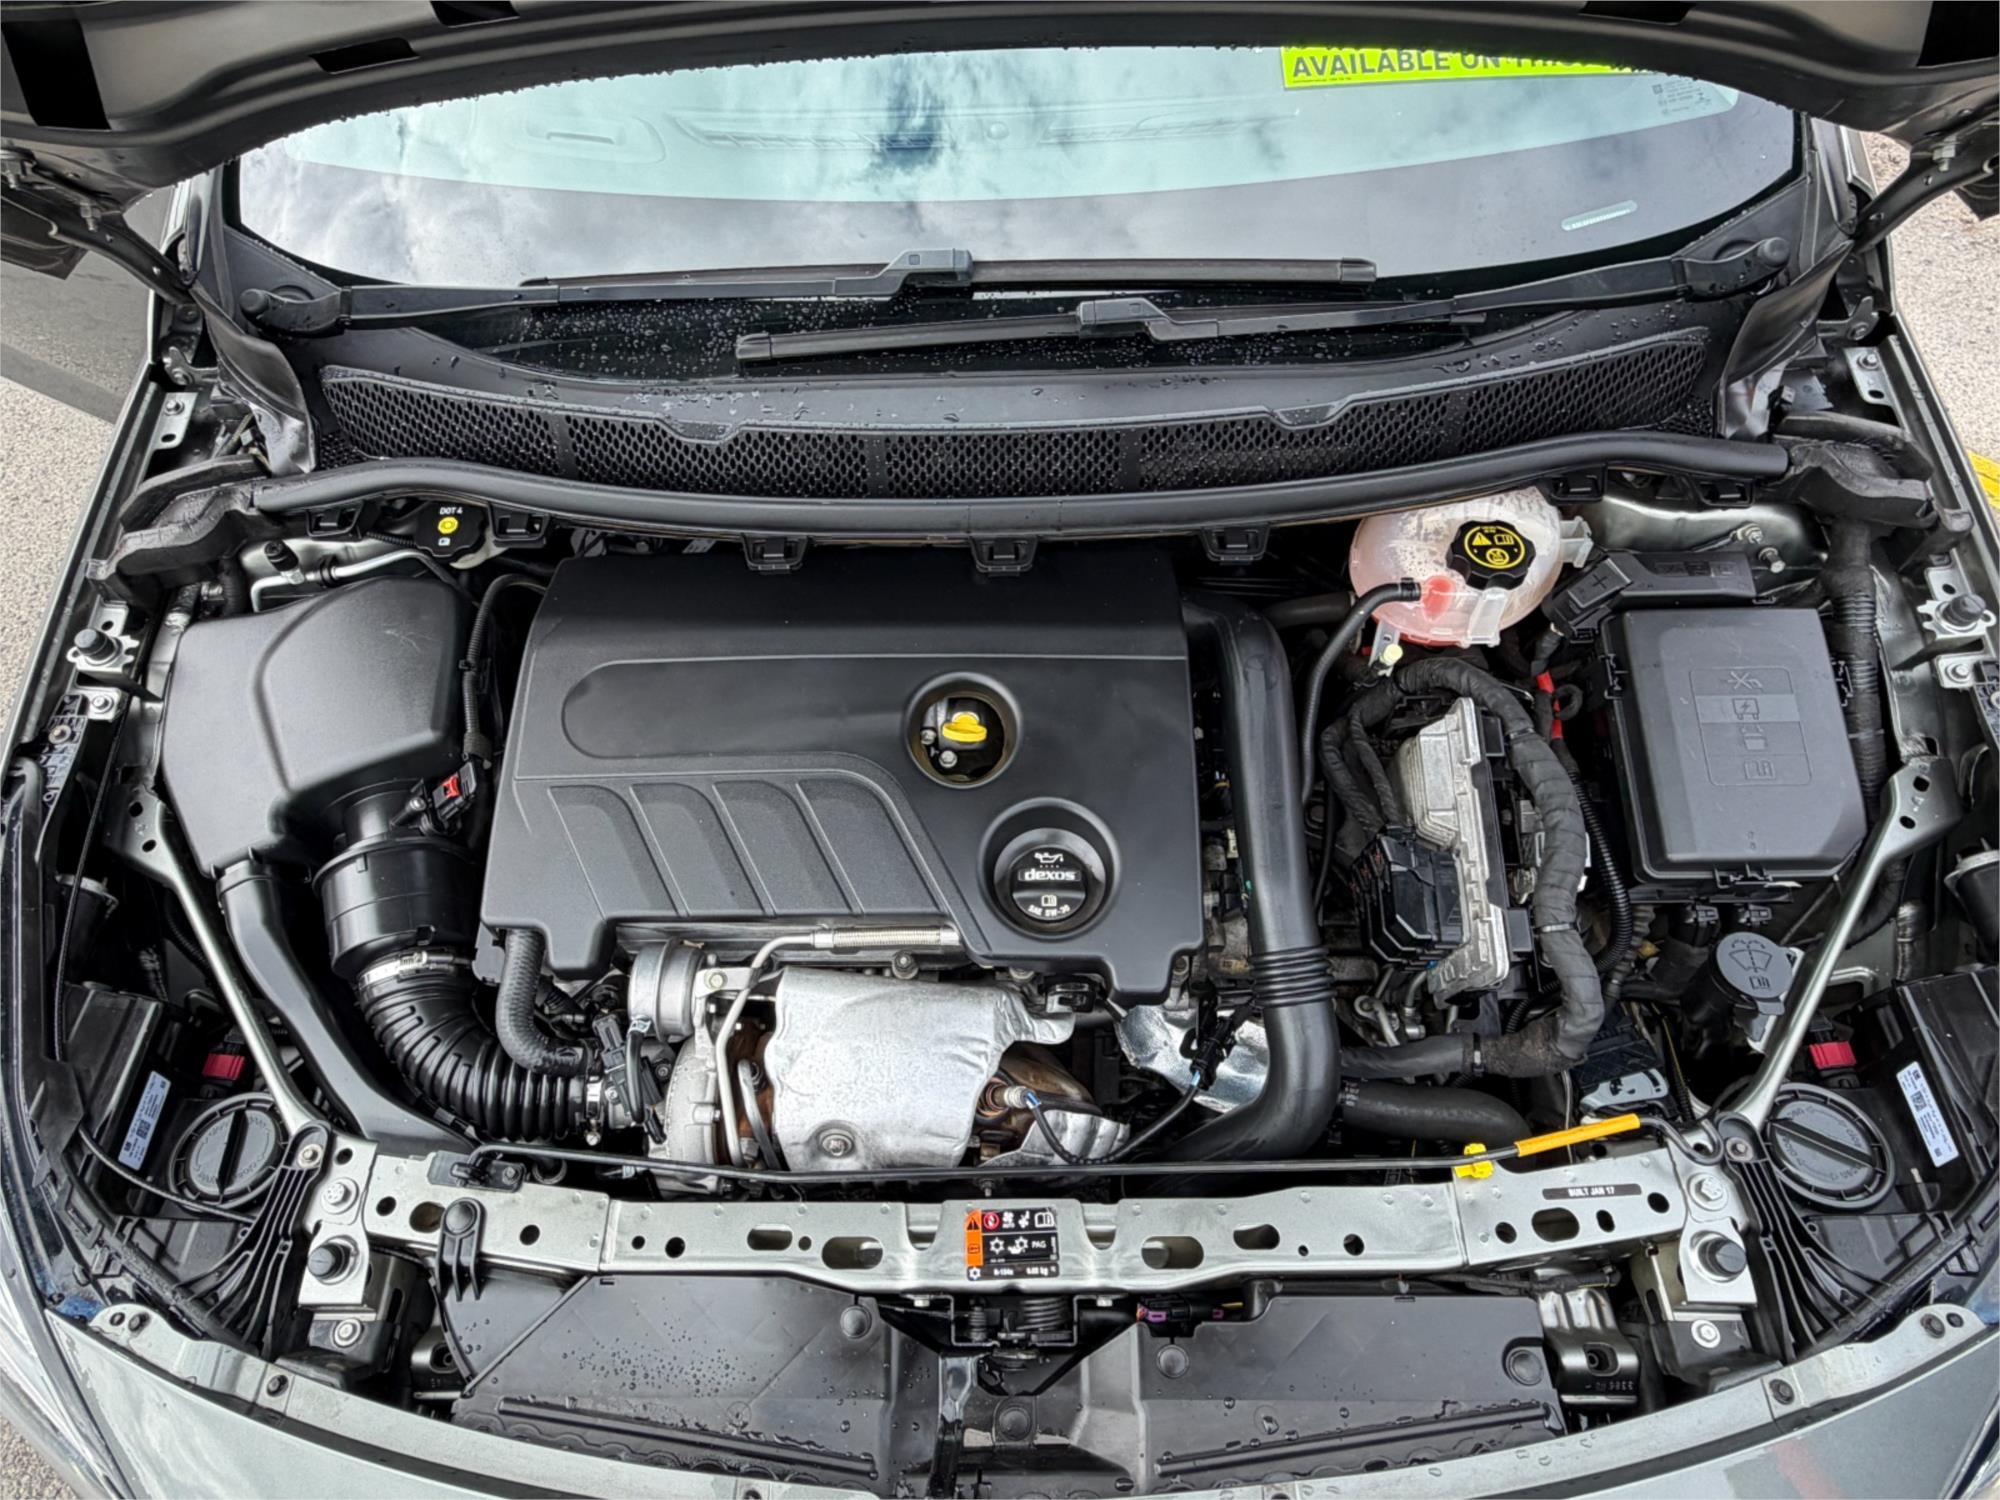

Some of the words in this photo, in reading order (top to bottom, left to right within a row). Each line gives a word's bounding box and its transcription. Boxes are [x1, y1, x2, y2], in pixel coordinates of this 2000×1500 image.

[1293, 51, 1450, 77] AVAILABLE
[440, 507, 456, 515] DOT
[1024, 868, 1076, 881] dexos
[1568, 1187, 1589, 1197] BUILT
[1591, 1186, 1605, 1196] JAN
[1031, 1240, 1047, 1249] PAG
